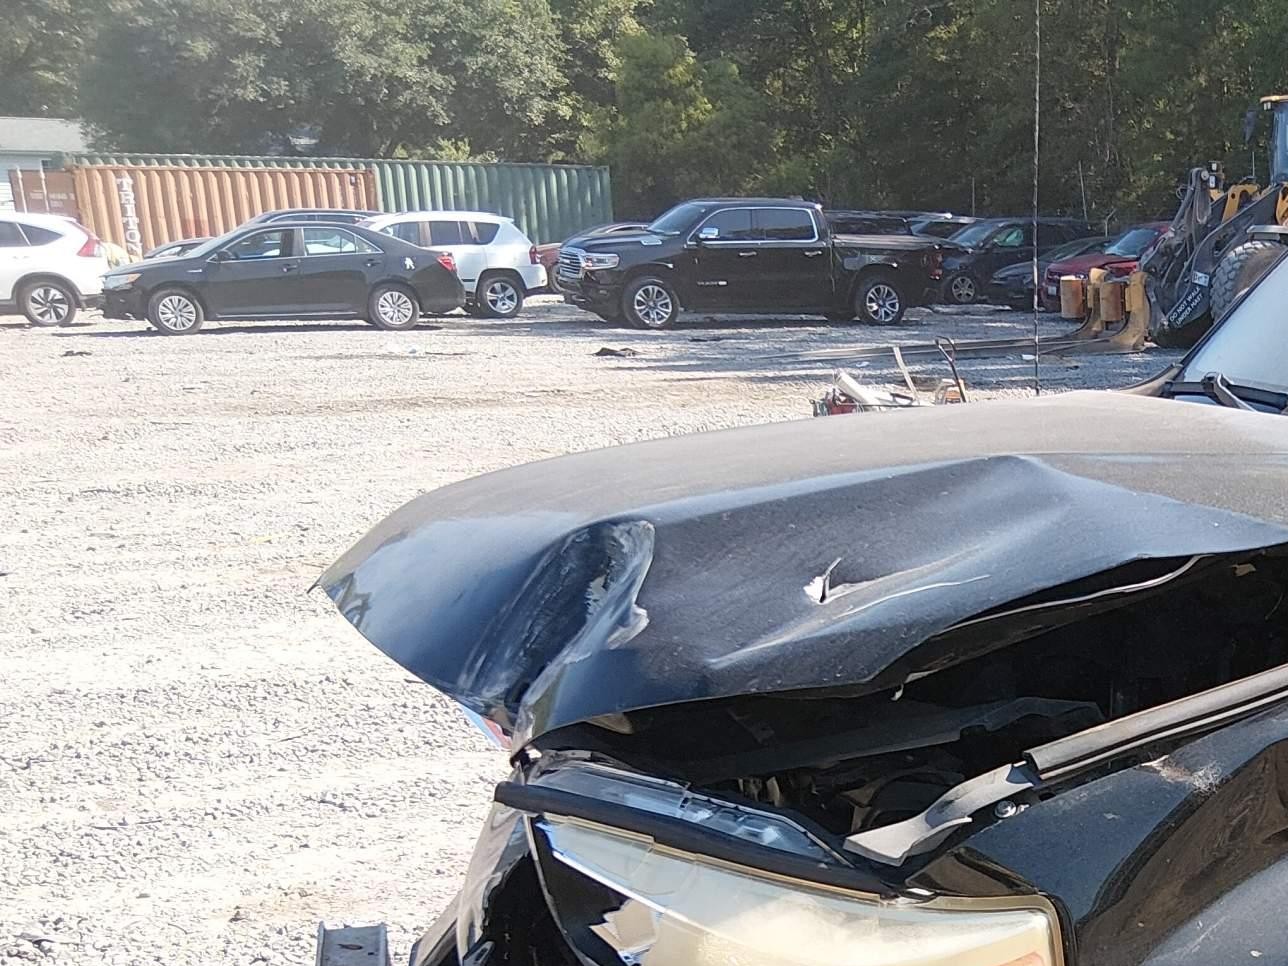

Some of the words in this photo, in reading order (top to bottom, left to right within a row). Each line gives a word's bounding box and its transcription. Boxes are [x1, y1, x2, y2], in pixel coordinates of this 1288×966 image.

[116, 178, 143, 261] TRITON
[1176, 307, 1192, 325] UNDER
[1191, 293, 1202, 308] MAST
[1177, 301, 1188, 314] NOT
